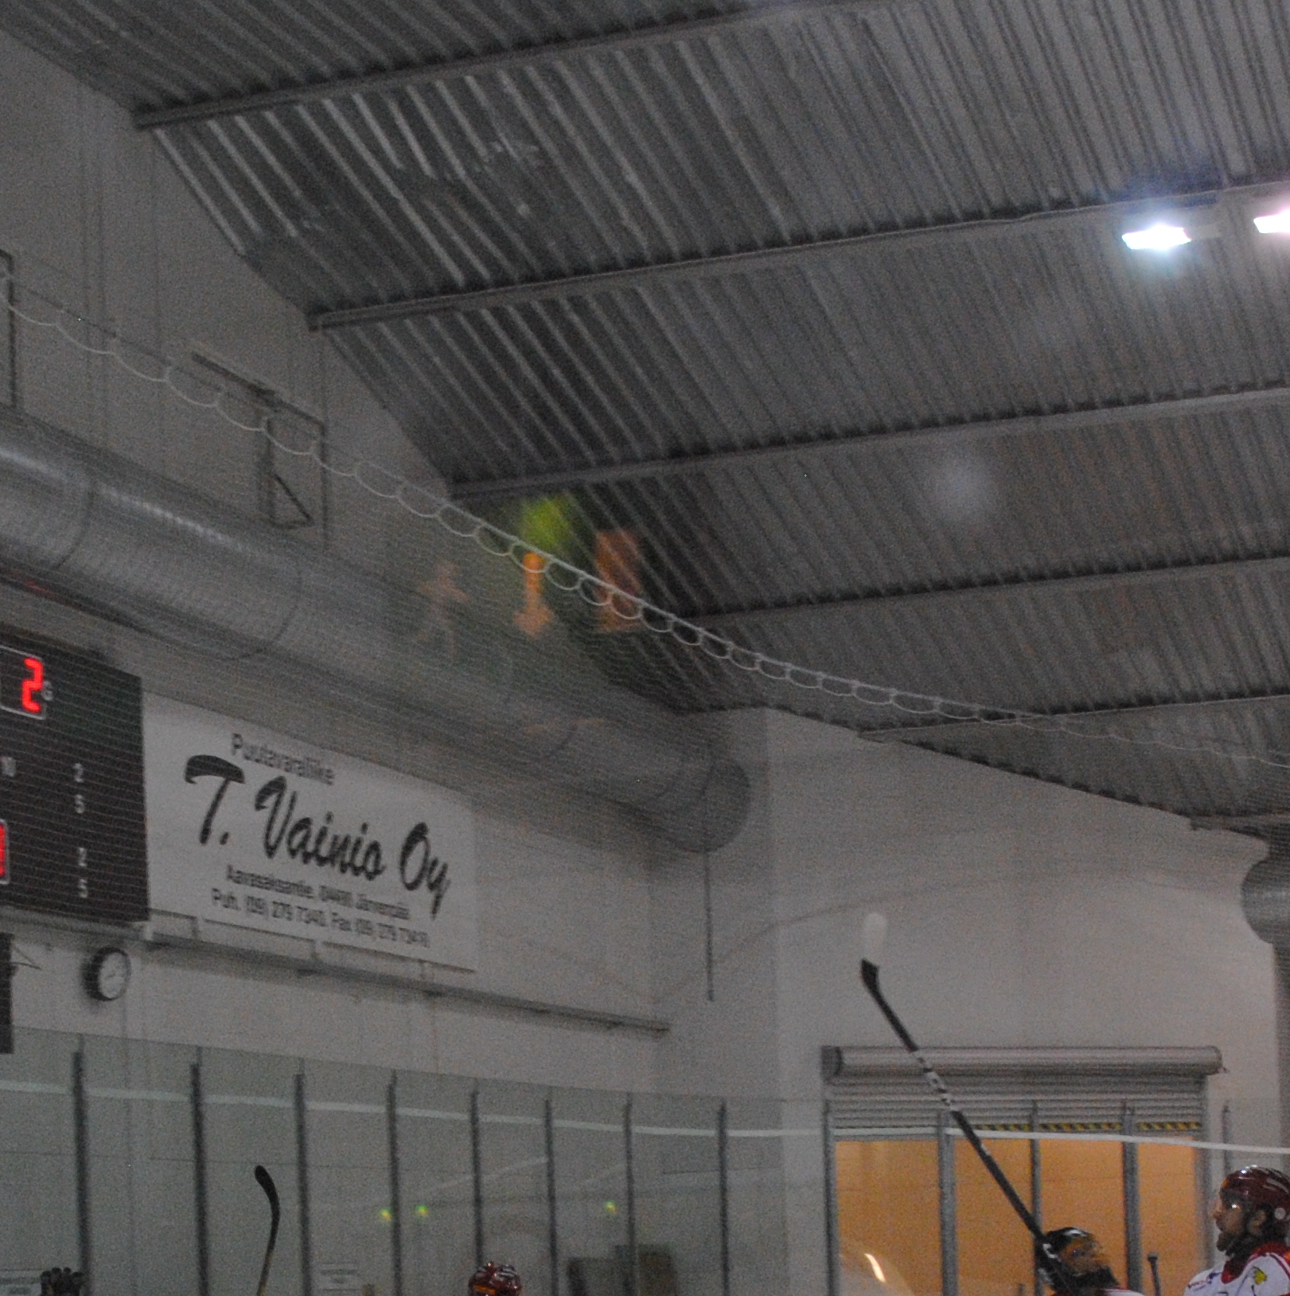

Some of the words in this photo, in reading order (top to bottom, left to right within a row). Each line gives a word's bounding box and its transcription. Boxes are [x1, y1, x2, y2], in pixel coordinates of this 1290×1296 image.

[20, 656, 44, 713] 2
[73, 762, 84, 784] 2
[184, 754, 246, 846] T.
[254, 775, 387, 882] Vainio
[399, 821, 452, 920] Oy
[76, 847, 87, 868] 2
[78, 878, 89, 899] 5
